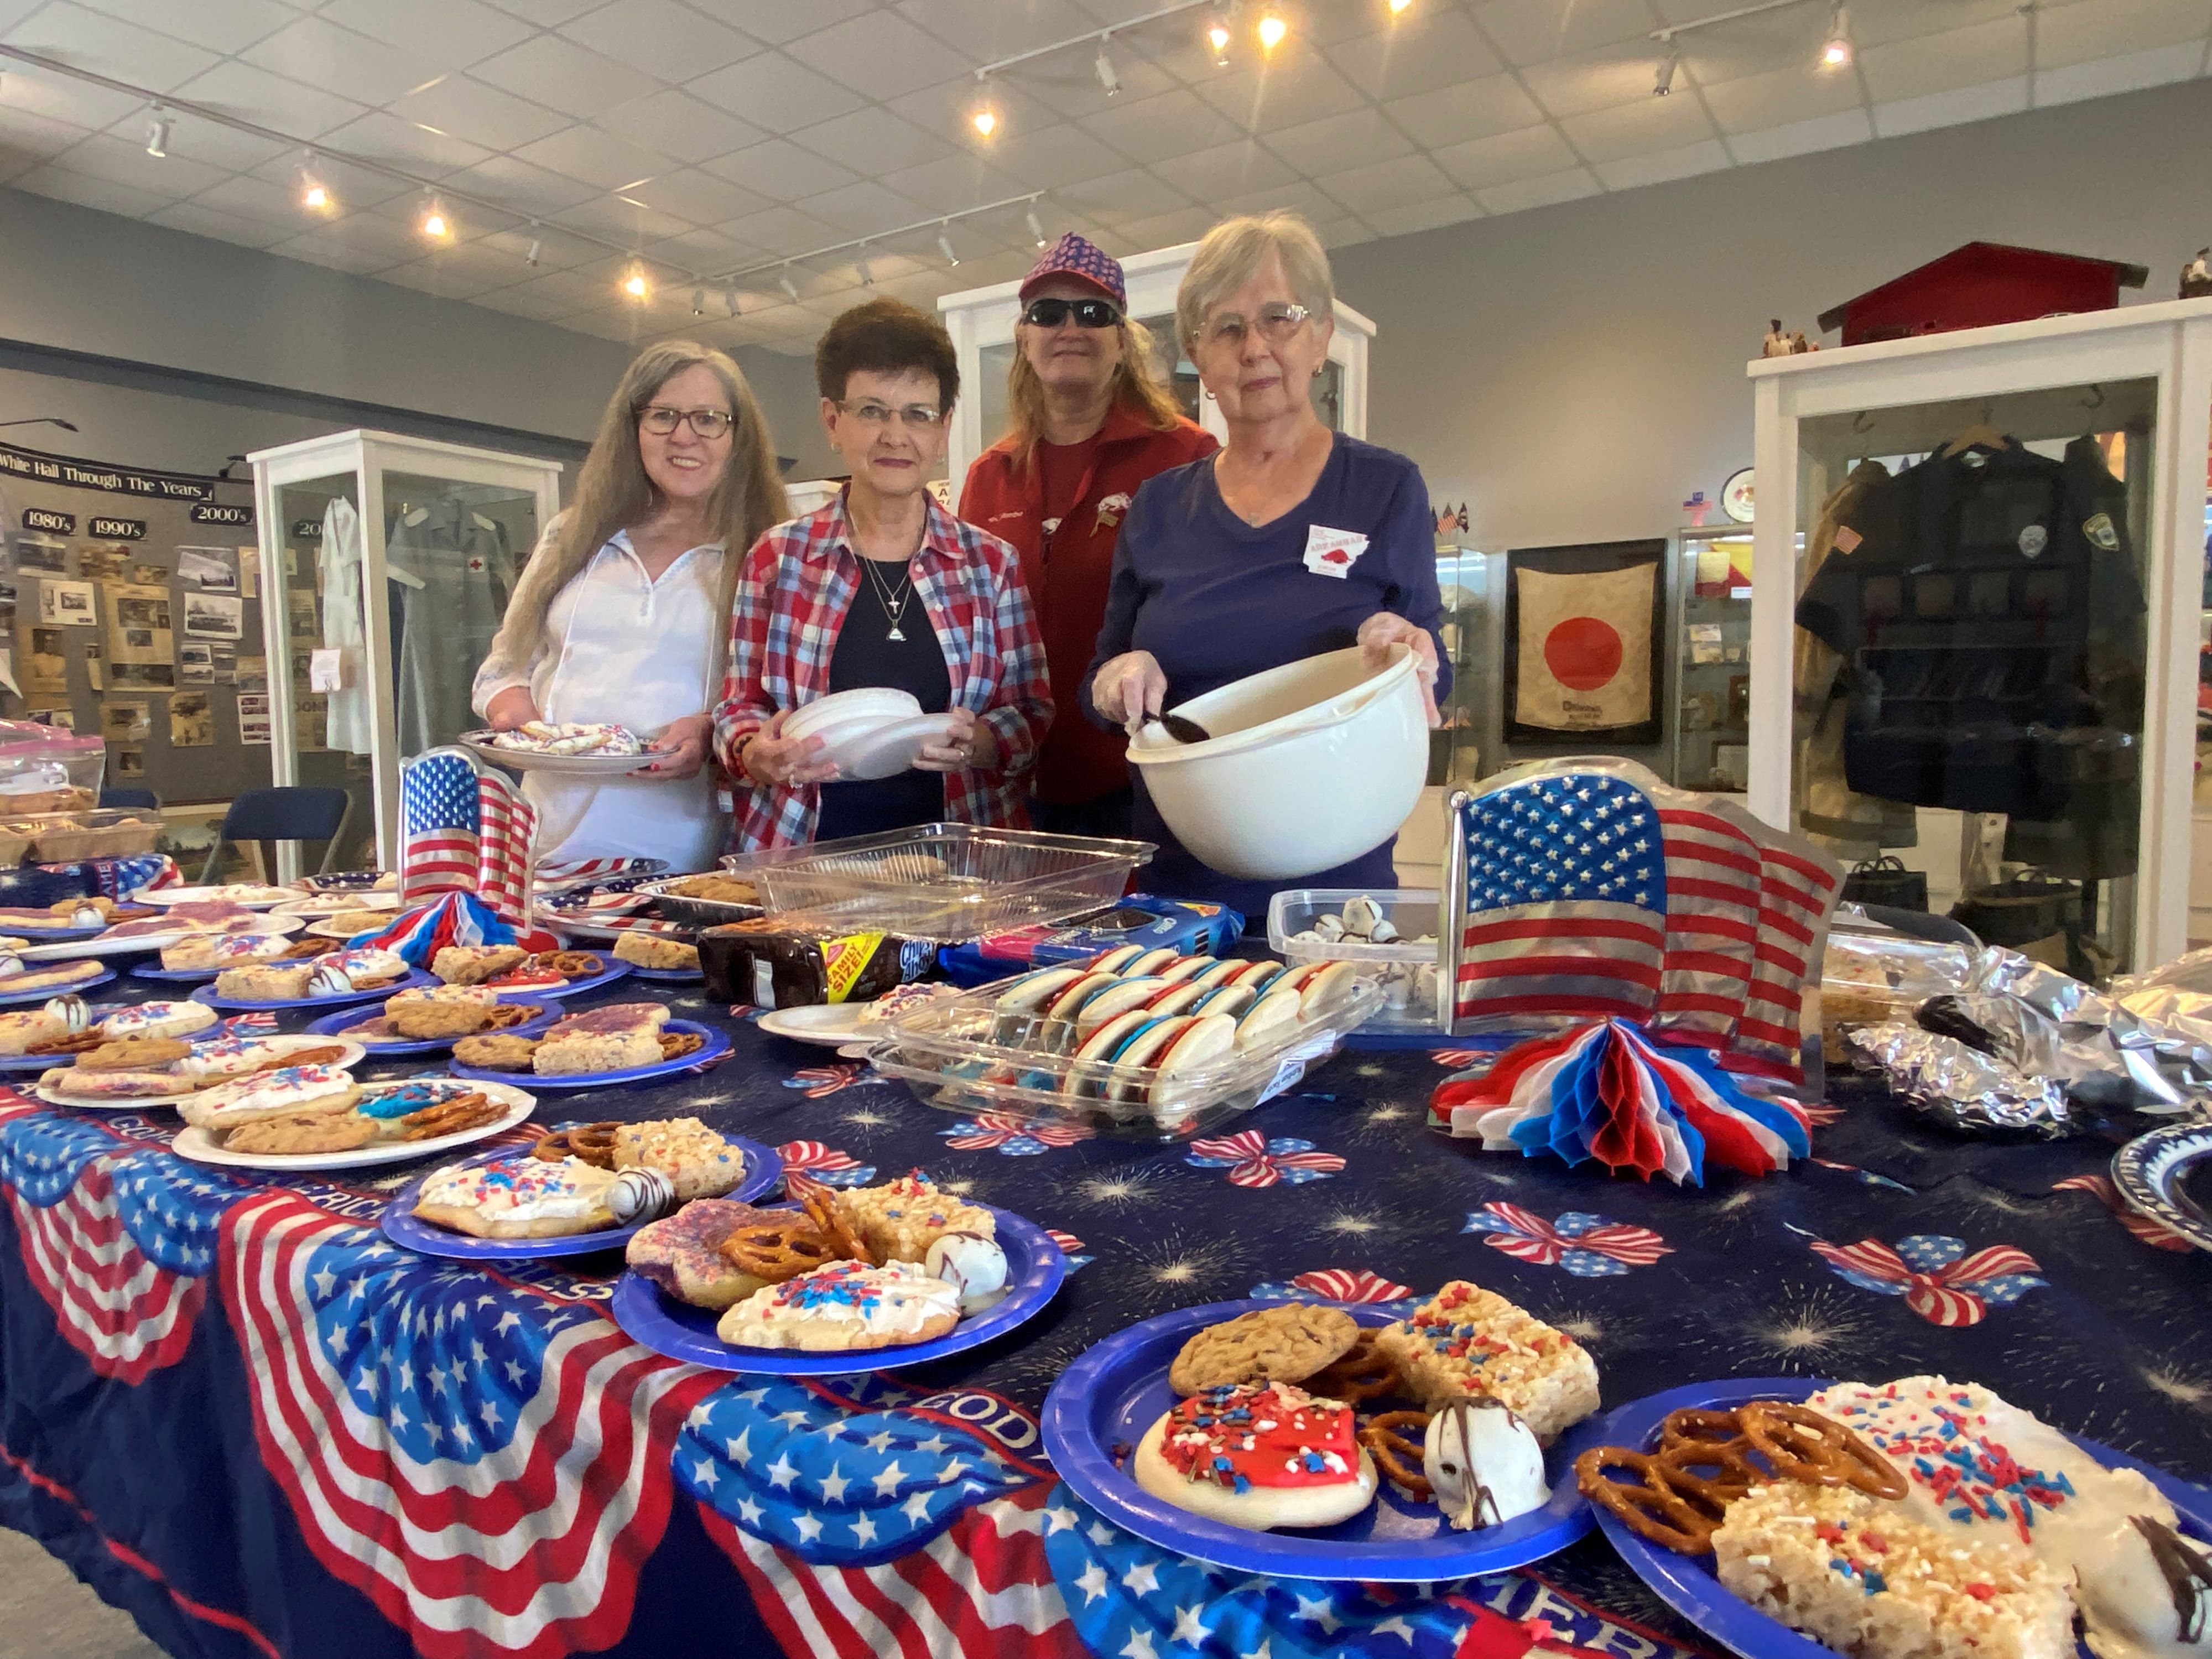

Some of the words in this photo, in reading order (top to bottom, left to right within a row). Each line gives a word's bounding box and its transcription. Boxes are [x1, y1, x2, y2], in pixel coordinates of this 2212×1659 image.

[0, 454, 31, 473] White
[34, 462, 60, 479] Hall
[64, 467, 122, 489] Through
[126, 477, 155, 492] The
[160, 481, 202, 497] Years
[28, 511, 71, 531] 1980's
[95, 519, 141, 537] 1990's
[197, 506, 247, 522] 2000's
[827, 943, 858, 985] FAMILY
[833, 951, 863, 993] SIZE!
[911, 1391, 1038, 1449] GOD
